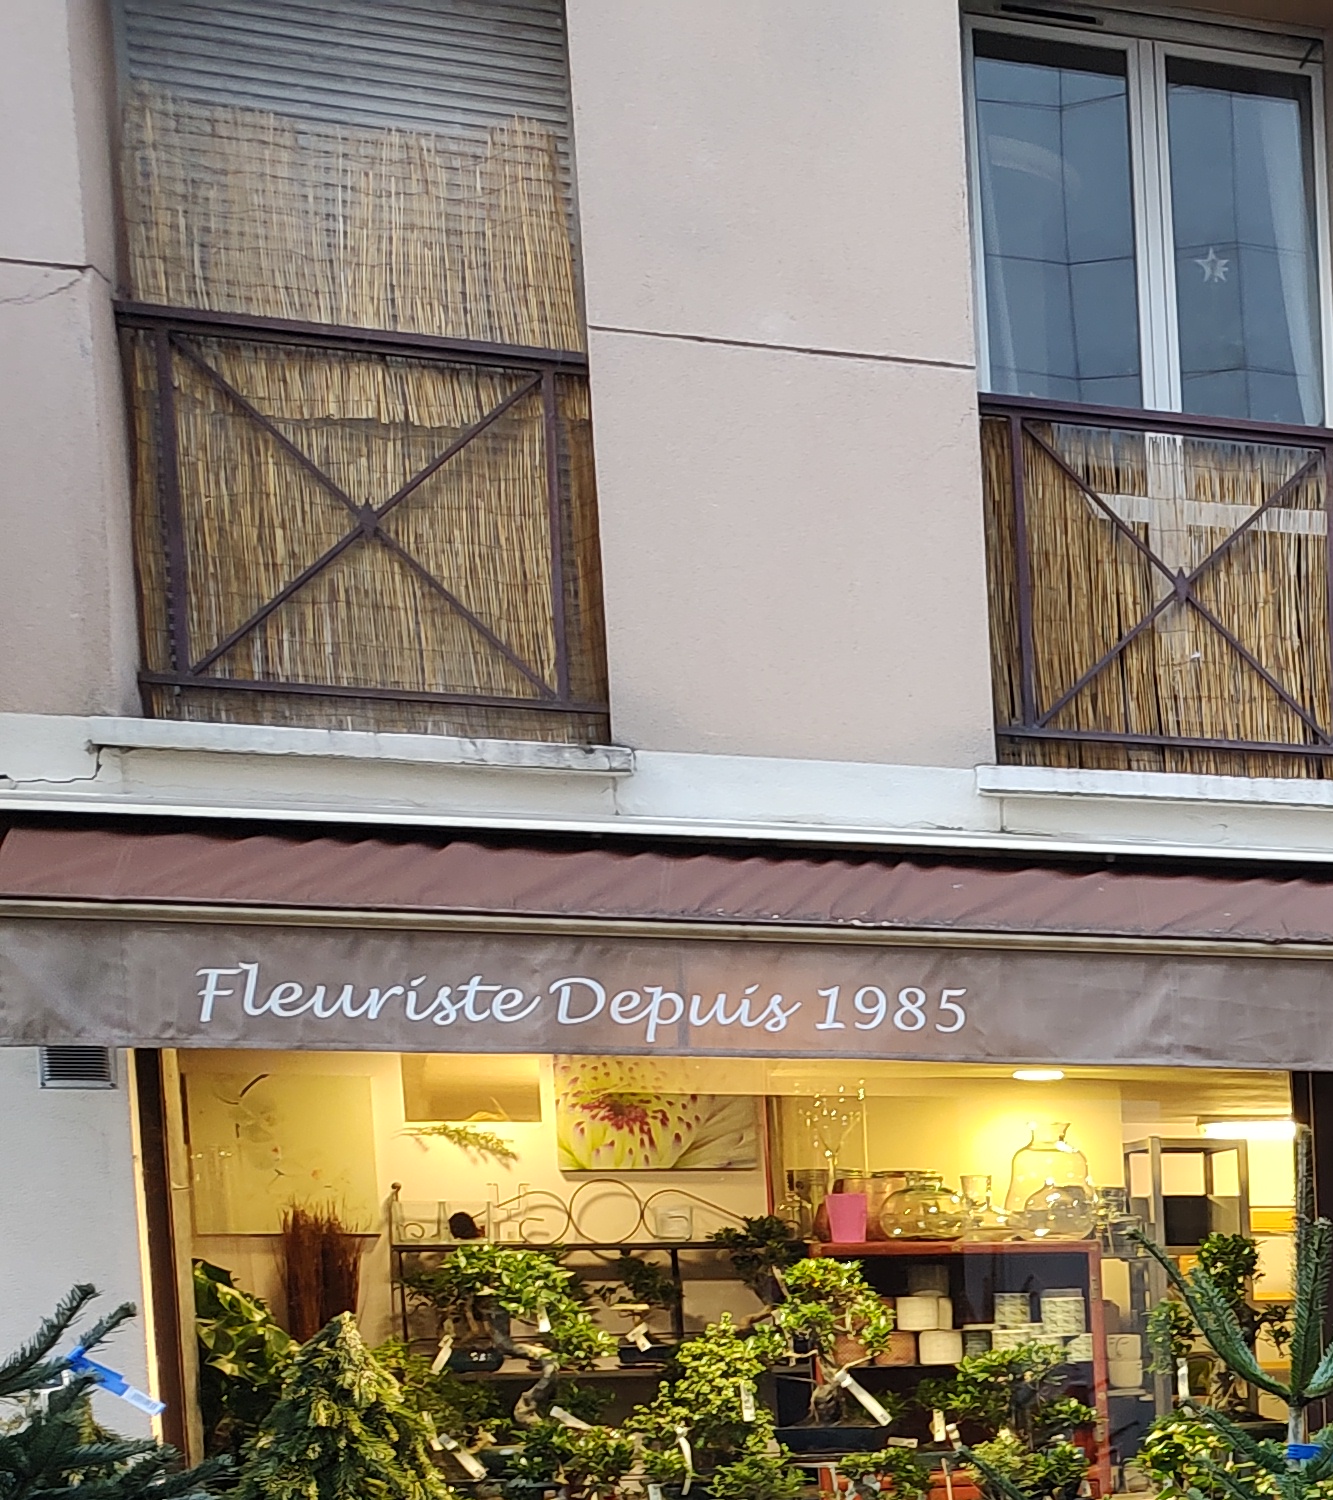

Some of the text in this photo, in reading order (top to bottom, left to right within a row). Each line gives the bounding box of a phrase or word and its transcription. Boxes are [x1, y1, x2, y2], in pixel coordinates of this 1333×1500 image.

[195, 961, 968, 1043] Fleuriste Depuis 1985
